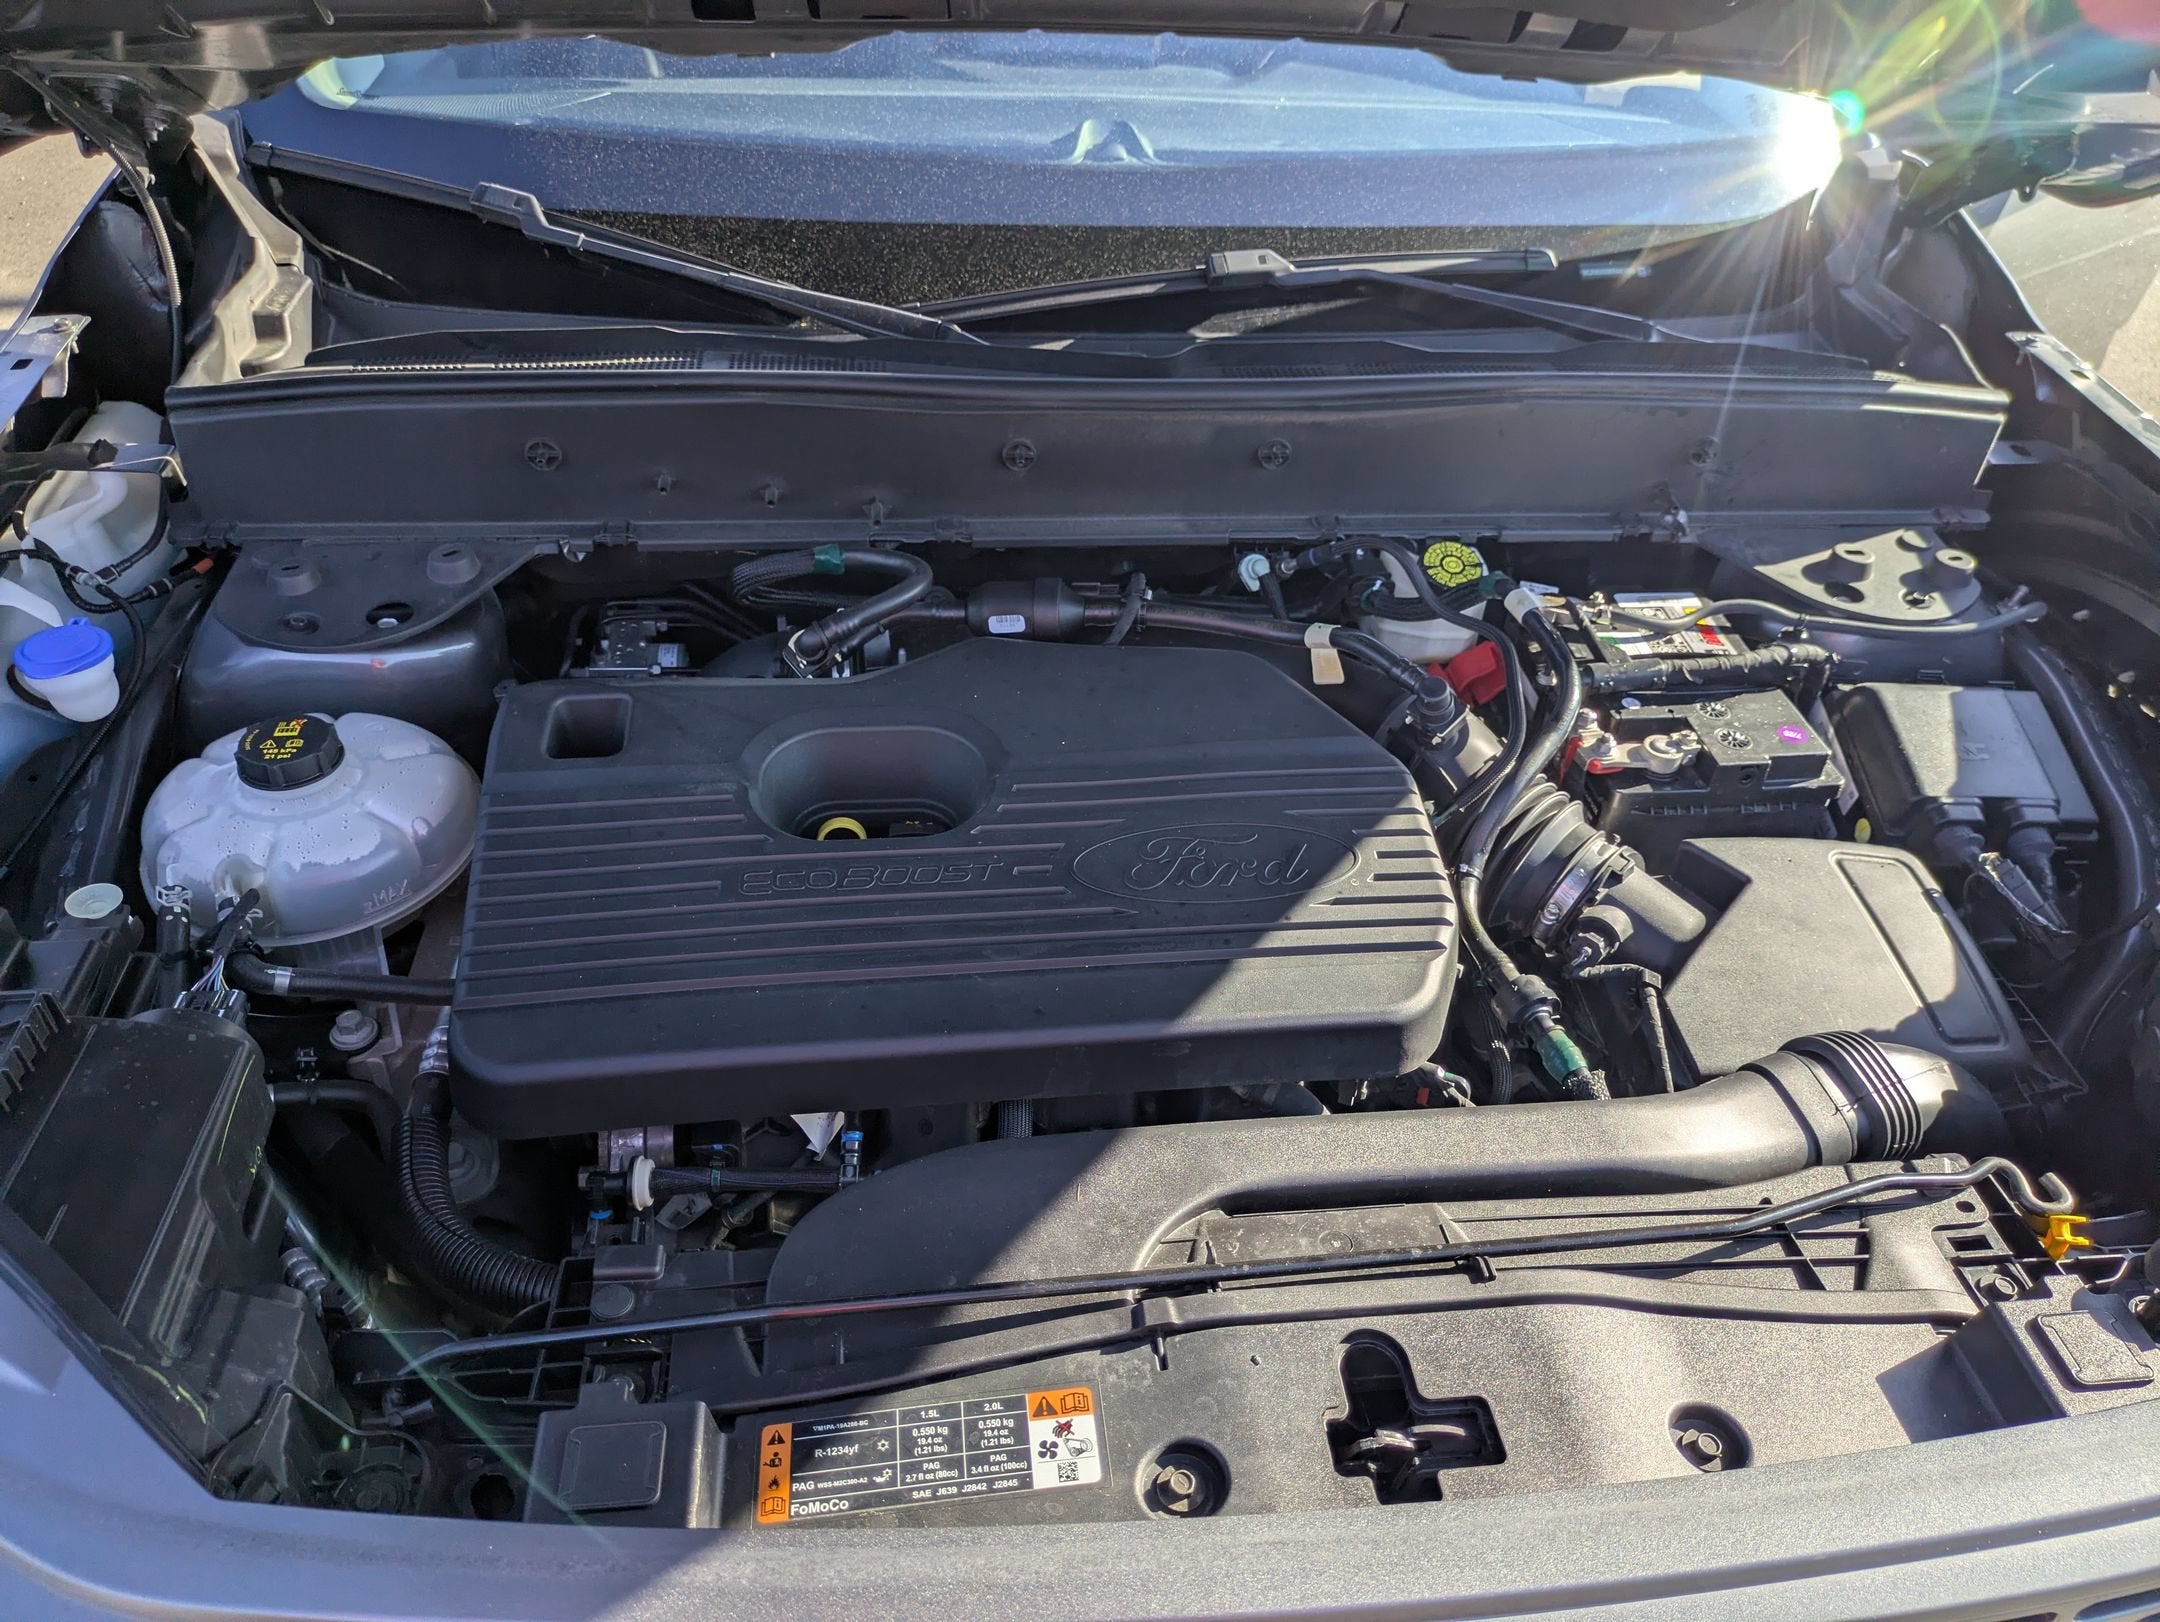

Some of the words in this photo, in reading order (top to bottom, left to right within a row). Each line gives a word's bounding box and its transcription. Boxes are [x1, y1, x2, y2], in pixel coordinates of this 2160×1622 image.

[1124, 834, 1309, 890] Ford
[984, 1402, 1004, 1411] 2.0L
[920, 1409, 940, 1419] 1.5L
[978, 1419, 1001, 1429] 0.550
[1003, 1418, 1014, 1428] kg
[912, 1427, 936, 1437] 0.550
[937, 1425, 949, 1435] kg
[980, 1439, 998, 1448] (1.21
[1000, 1436, 1014, 1445] lbs)
[815, 1444, 859, 1458] R-1234yf
[914, 1446, 932, 1456] (1.21
[933, 1444, 948, 1453] lbs)
[990, 1454, 1007, 1462] PAG
[923, 1462, 940, 1470] PAG
[971, 1466, 982, 1474] 3.4
[1000, 1461, 1028, 1472] (100cc)
[906, 1474, 917, 1482] 2.7
[792, 1481, 815, 1492] PAG
[912, 1490, 932, 1499] SAE
[936, 1486, 958, 1496] J639
[962, 1482, 987, 1492] J2842
[992, 1479, 1018, 1489] J2845
[790, 1498, 849, 1516] FoMoCo
